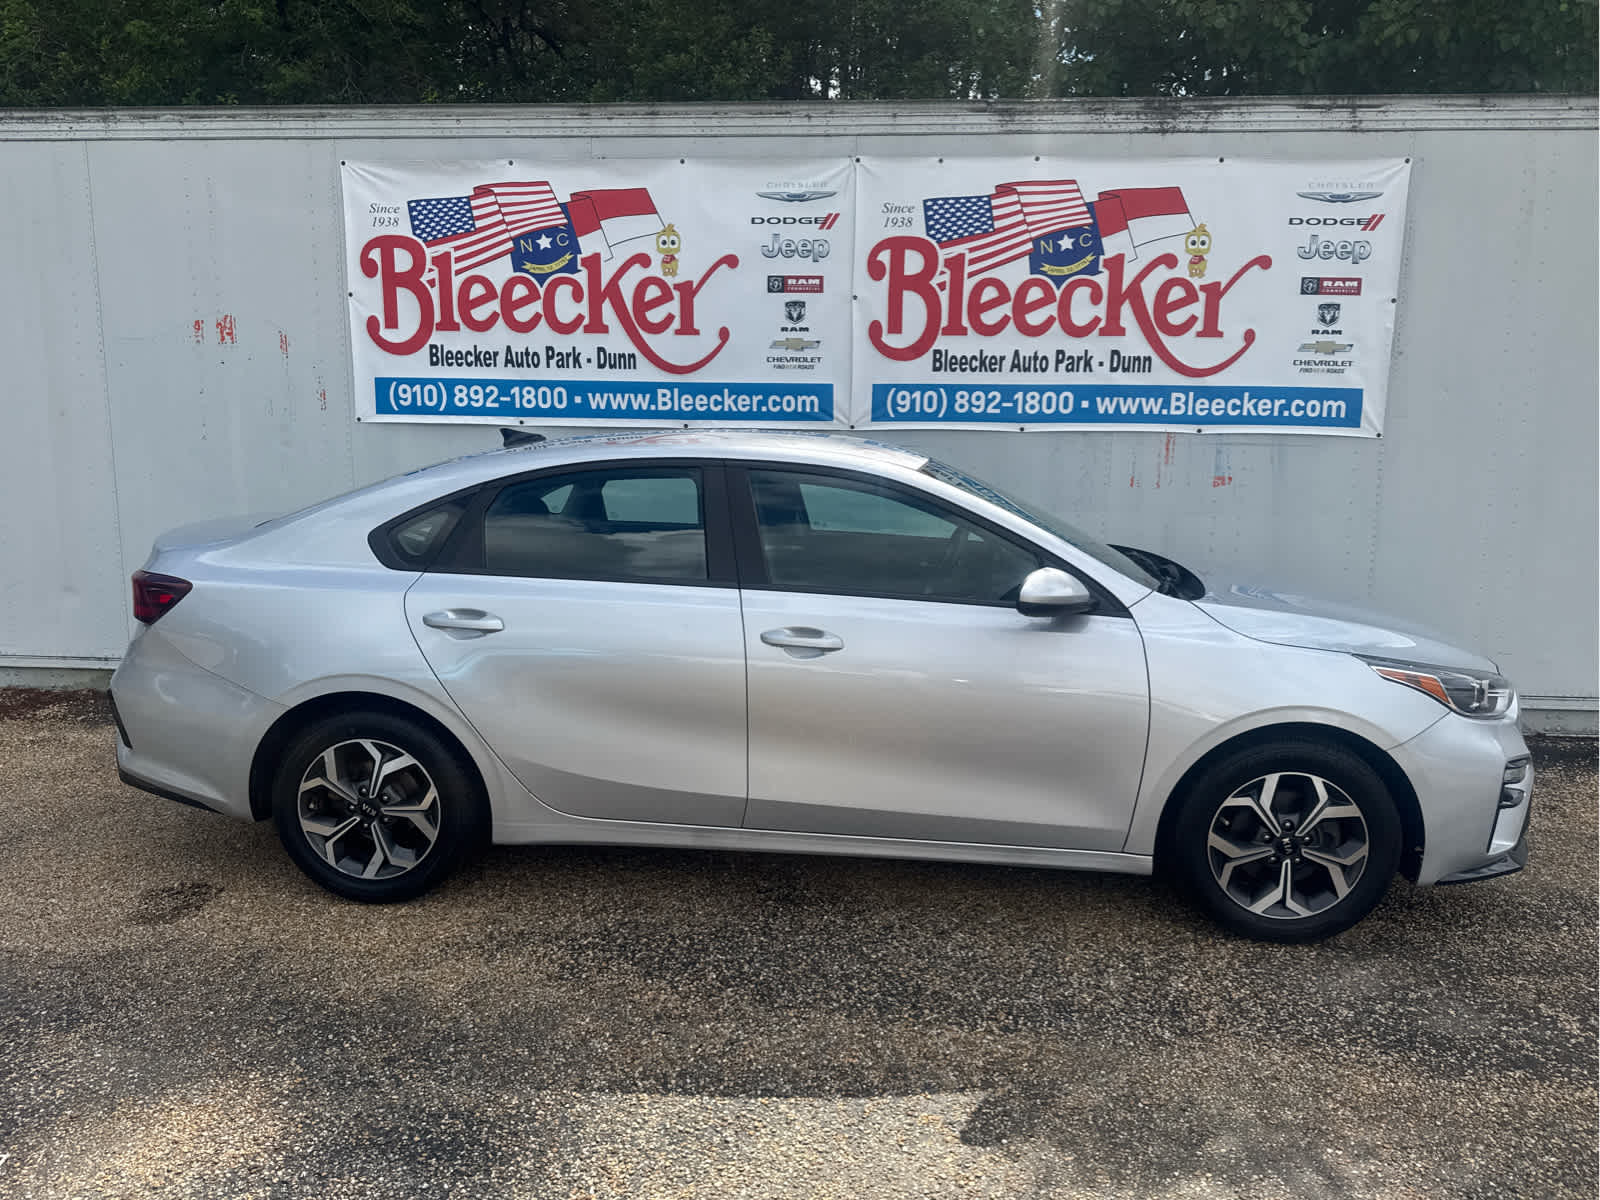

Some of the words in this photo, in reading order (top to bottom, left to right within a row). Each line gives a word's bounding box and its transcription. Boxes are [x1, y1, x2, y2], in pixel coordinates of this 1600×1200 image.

[369, 203, 400, 213] Since
[882, 202, 915, 213] Since
[372, 217, 399, 227] 1938
[751, 216, 827, 225] DODGE
[884, 217, 914, 228] 1938
[1289, 217, 1372, 226] DODGE
[761, 234, 830, 262] Jeep
[1297, 235, 1371, 264] Jeep
[360, 235, 738, 374] Bleecker
[868, 236, 1272, 377] Bleecker
[429, 345, 499, 368] Bleecker
[504, 346, 540, 368] Auto
[546, 346, 582, 368] Park
[597, 347, 637, 369] Dunn
[766, 356, 823, 364] CHEVROLET
[931, 348, 1006, 373] Bleecker
[1010, 350, 1049, 373] Auto
[1054, 350, 1093, 372] Park
[1109, 351, 1152, 373] Dunn
[1293, 359, 1353, 367] CHEVROLET
[389, 382, 447, 411] (910)
[454, 385, 567, 409] 892-1800
[588, 388, 819, 412] www.Bleecker.com
[887, 388, 947, 417] (910)
[954, 391, 1074, 415] 892-1800
[1096, 392, 1346, 418] www.Bleecker.com
